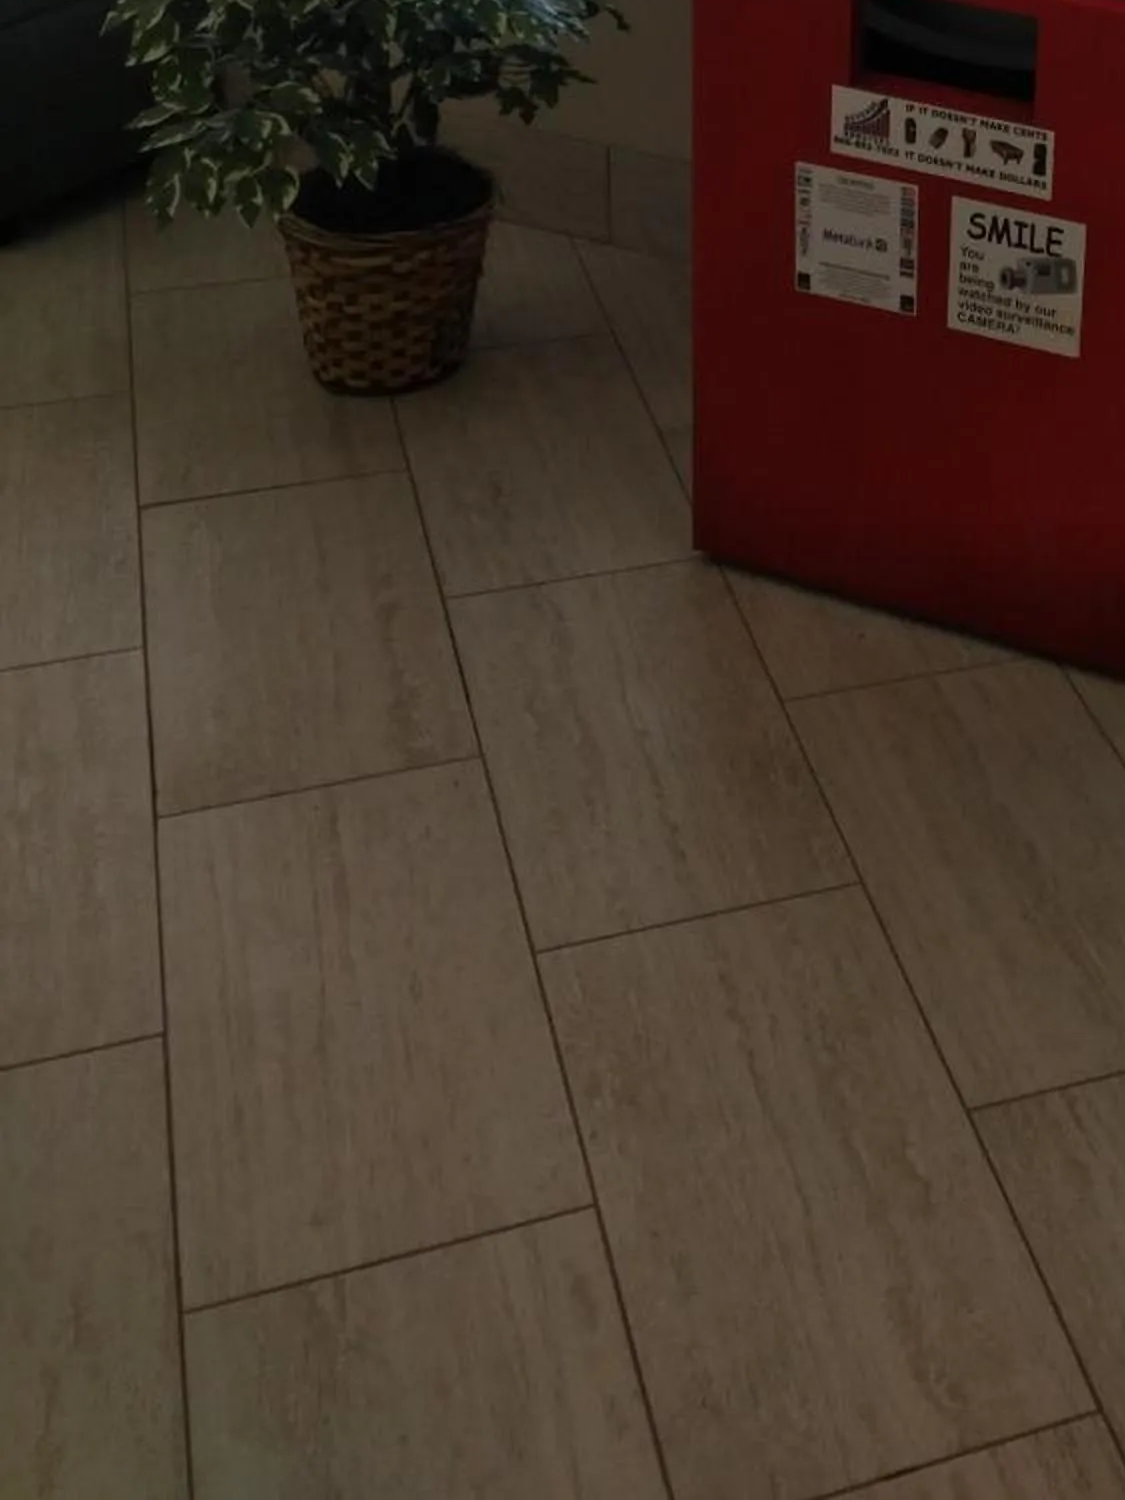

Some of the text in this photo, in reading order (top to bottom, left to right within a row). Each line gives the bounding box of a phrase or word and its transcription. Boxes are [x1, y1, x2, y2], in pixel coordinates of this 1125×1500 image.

[905, 104, 915, 113] IF
[919, 107, 928, 116] IT
[931, 110, 978, 127] DOESN'T
[979, 118, 1010, 134] MAKE
[905, 151, 1047, 190] IT DOESN'T MAKE DOLLARS
[967, 212, 1065, 258] SMILE
[959, 262, 979, 274] are
[960, 245, 985, 261] You
[959, 273, 996, 293] being
[958, 287, 1057, 318] watched by our
[958, 300, 1075, 336] video surveillance
